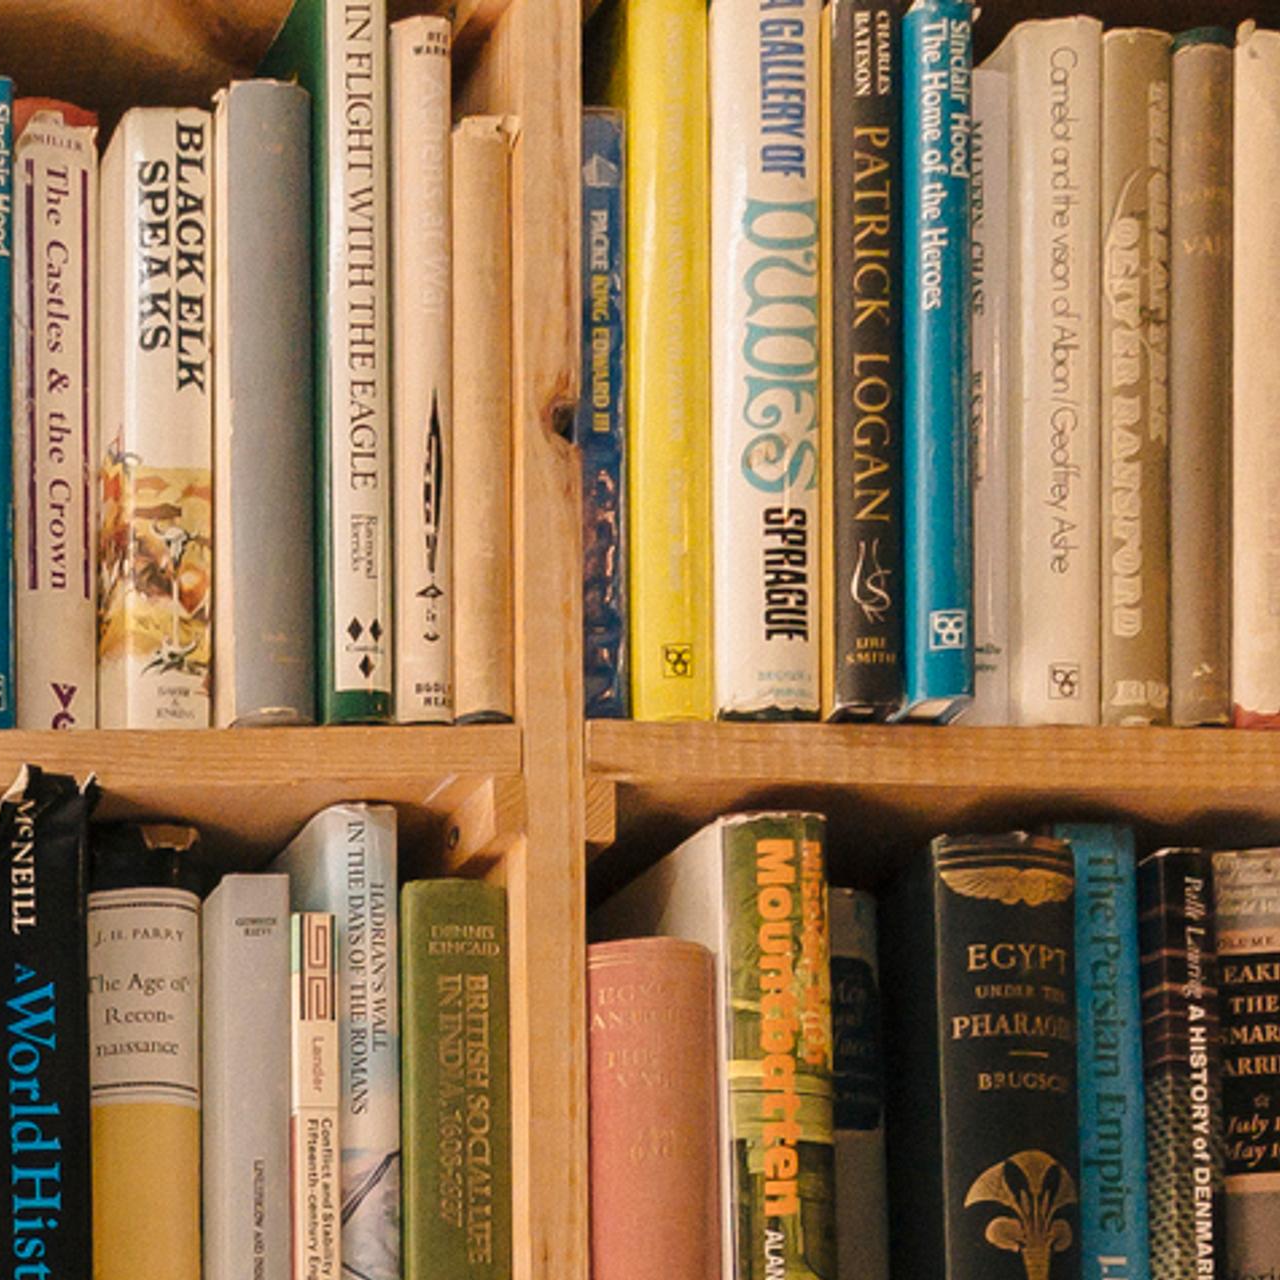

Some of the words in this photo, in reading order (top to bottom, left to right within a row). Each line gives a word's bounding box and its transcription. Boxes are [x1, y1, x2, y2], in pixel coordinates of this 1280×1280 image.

[347, 53, 373, 177] FLIGHT
[45, 166, 68, 225] The
[177, 122, 203, 287] BLACK
[349, 187, 375, 286] WITH
[853, 125, 889, 329] PATRICK
[46, 240, 70, 351] Castles
[139, 161, 170, 350] SPEAKS
[48, 375, 68, 395] &
[177, 294, 204, 393] ELK
[349, 297, 375, 371] THE
[49, 412, 71, 464] the
[350, 380, 377, 490] EAGLE
[853, 353, 891, 521] LOGAN
[48, 481, 72, 589] Crown
[763, 507, 808, 643] SPRAGUE
[5, 982, 61, 1152] World
[1187, 1027, 1209, 1135] HISTORY
[1191, 1139, 1211, 1160] of
